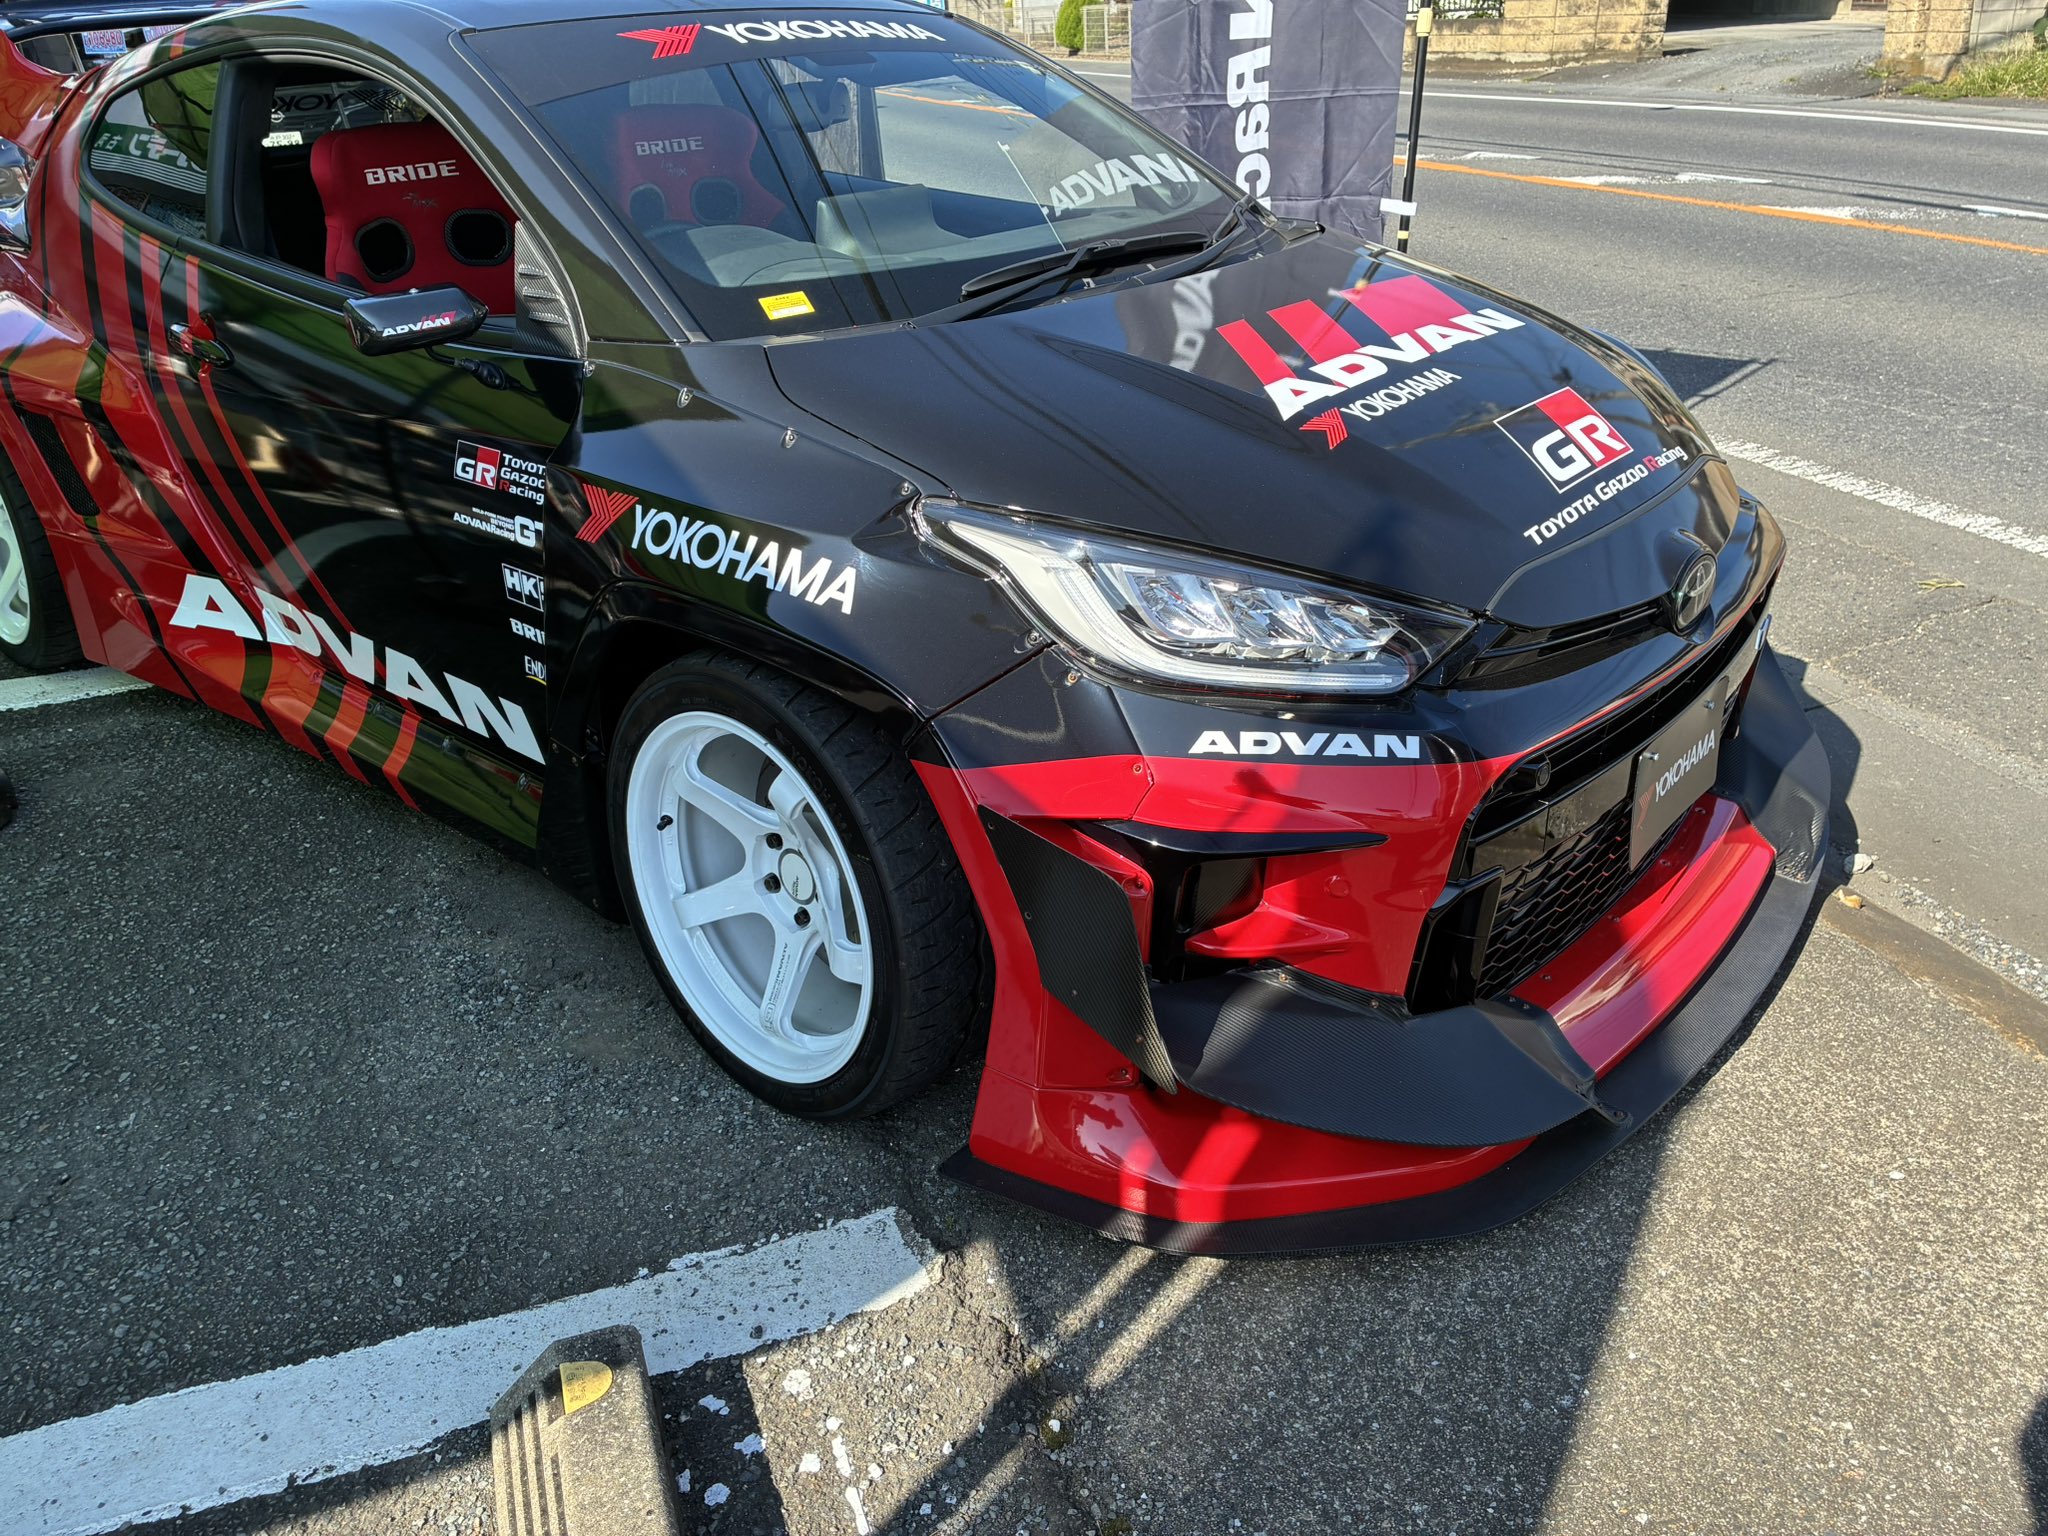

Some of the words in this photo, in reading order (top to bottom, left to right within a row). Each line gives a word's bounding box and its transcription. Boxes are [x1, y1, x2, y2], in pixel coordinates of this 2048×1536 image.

[703, 20, 947, 44] YOKOHAMA
[634, 136, 705, 156] BRIDE
[363, 159, 460, 186] BRIDE
[382, 316, 451, 337] ADVAN
[1263, 308, 1526, 422] ADVAN
[1340, 367, 1463, 422] YOKOHAMA
[1532, 414, 1627, 482] GR
[456, 457, 497, 487] GR
[502, 453, 546, 476] TOYOT
[499, 479, 545, 506] Racing
[1523, 493, 1600, 546] TOYOTA
[1594, 463, 1649, 501] GAZOO
[1642, 445, 1690, 472] Racing
[631, 504, 858, 615] YOKOHAMA
[504, 568, 545, 601] HK
[509, 617, 546, 646] BRI
[169, 573, 546, 766] ADVAN
[524, 655, 547, 681] END
[1188, 730, 1420, 759] ADVAN
[1655, 729, 1715, 802] YOKOHAMA
